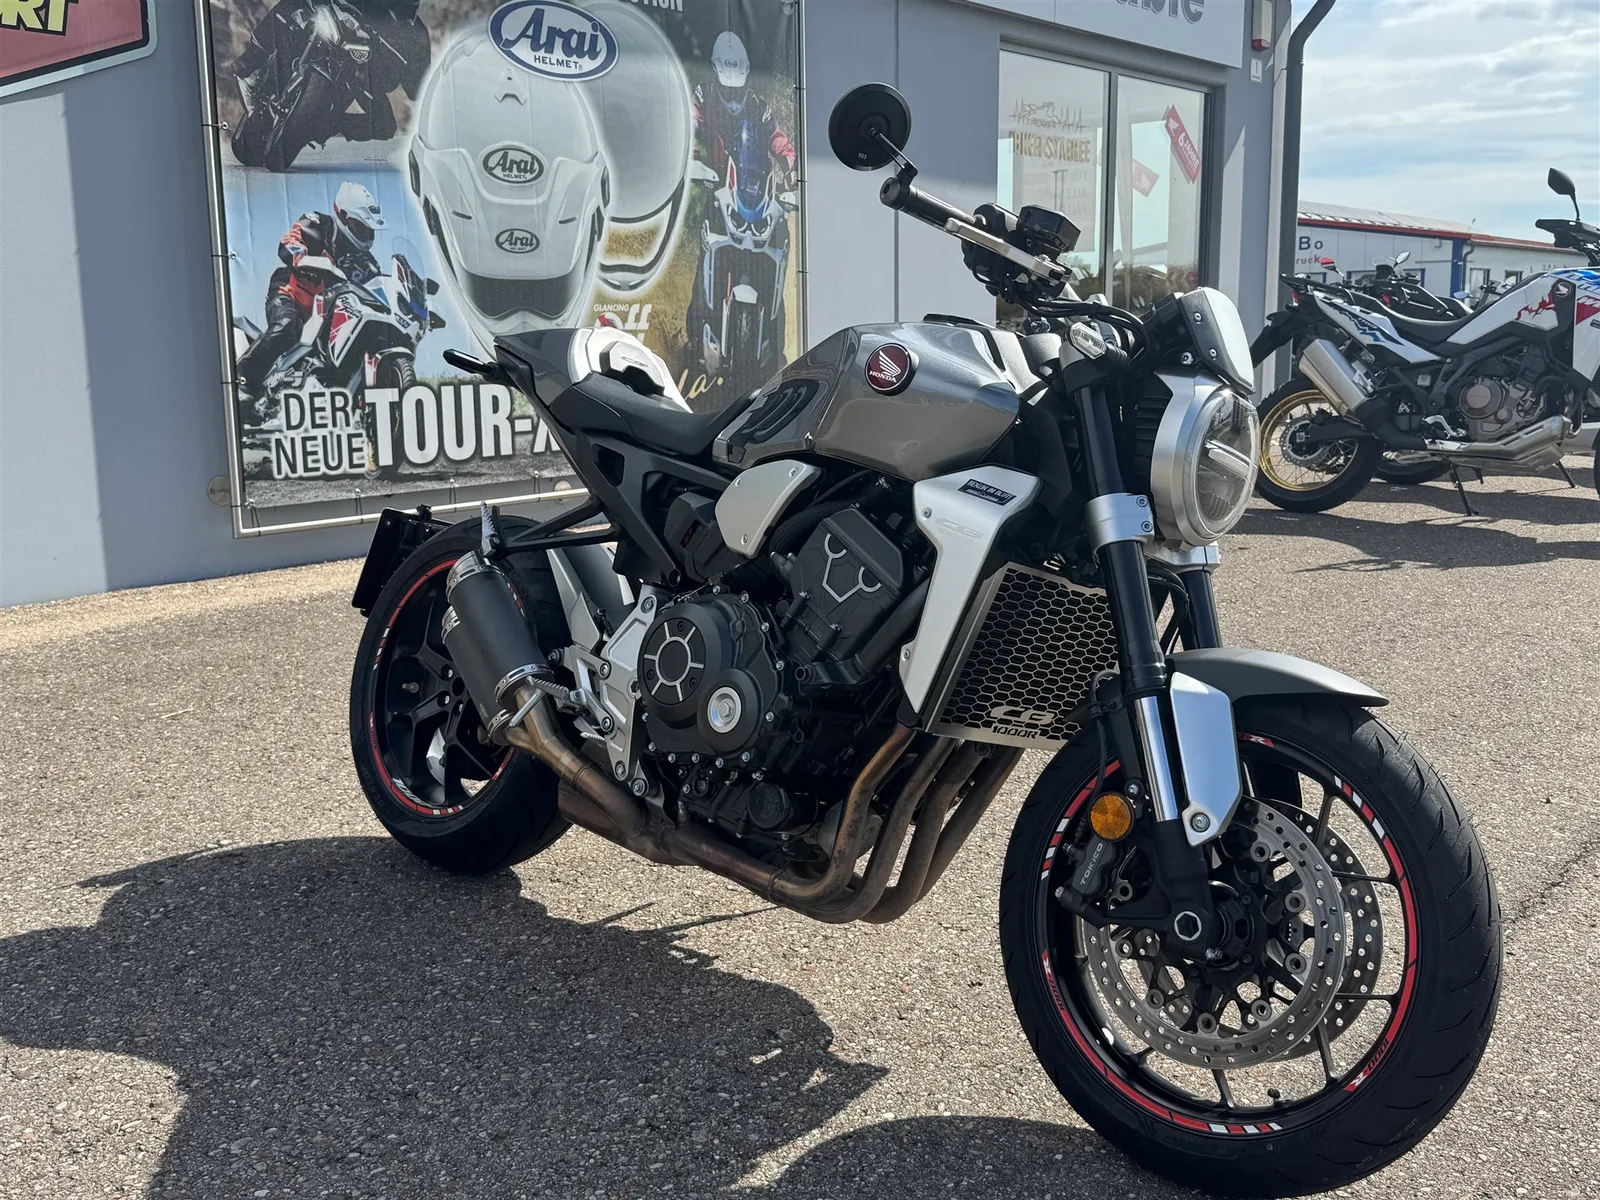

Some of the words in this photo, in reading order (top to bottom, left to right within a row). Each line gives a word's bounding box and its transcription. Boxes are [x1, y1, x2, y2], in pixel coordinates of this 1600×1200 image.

[501, 7, 603, 61] Arai
[487, 151, 537, 175] Arai
[499, 231, 536, 248] Arai
[593, 303, 630, 312] GLANCING
[869, 370, 897, 383] HONDA
[283, 390, 352, 431] DER
[274, 431, 365, 476] NEUE
[990, 706, 1055, 725] CB
[992, 725, 1038, 739] 1000R
[1080, 842, 1103, 886] TOKICO
